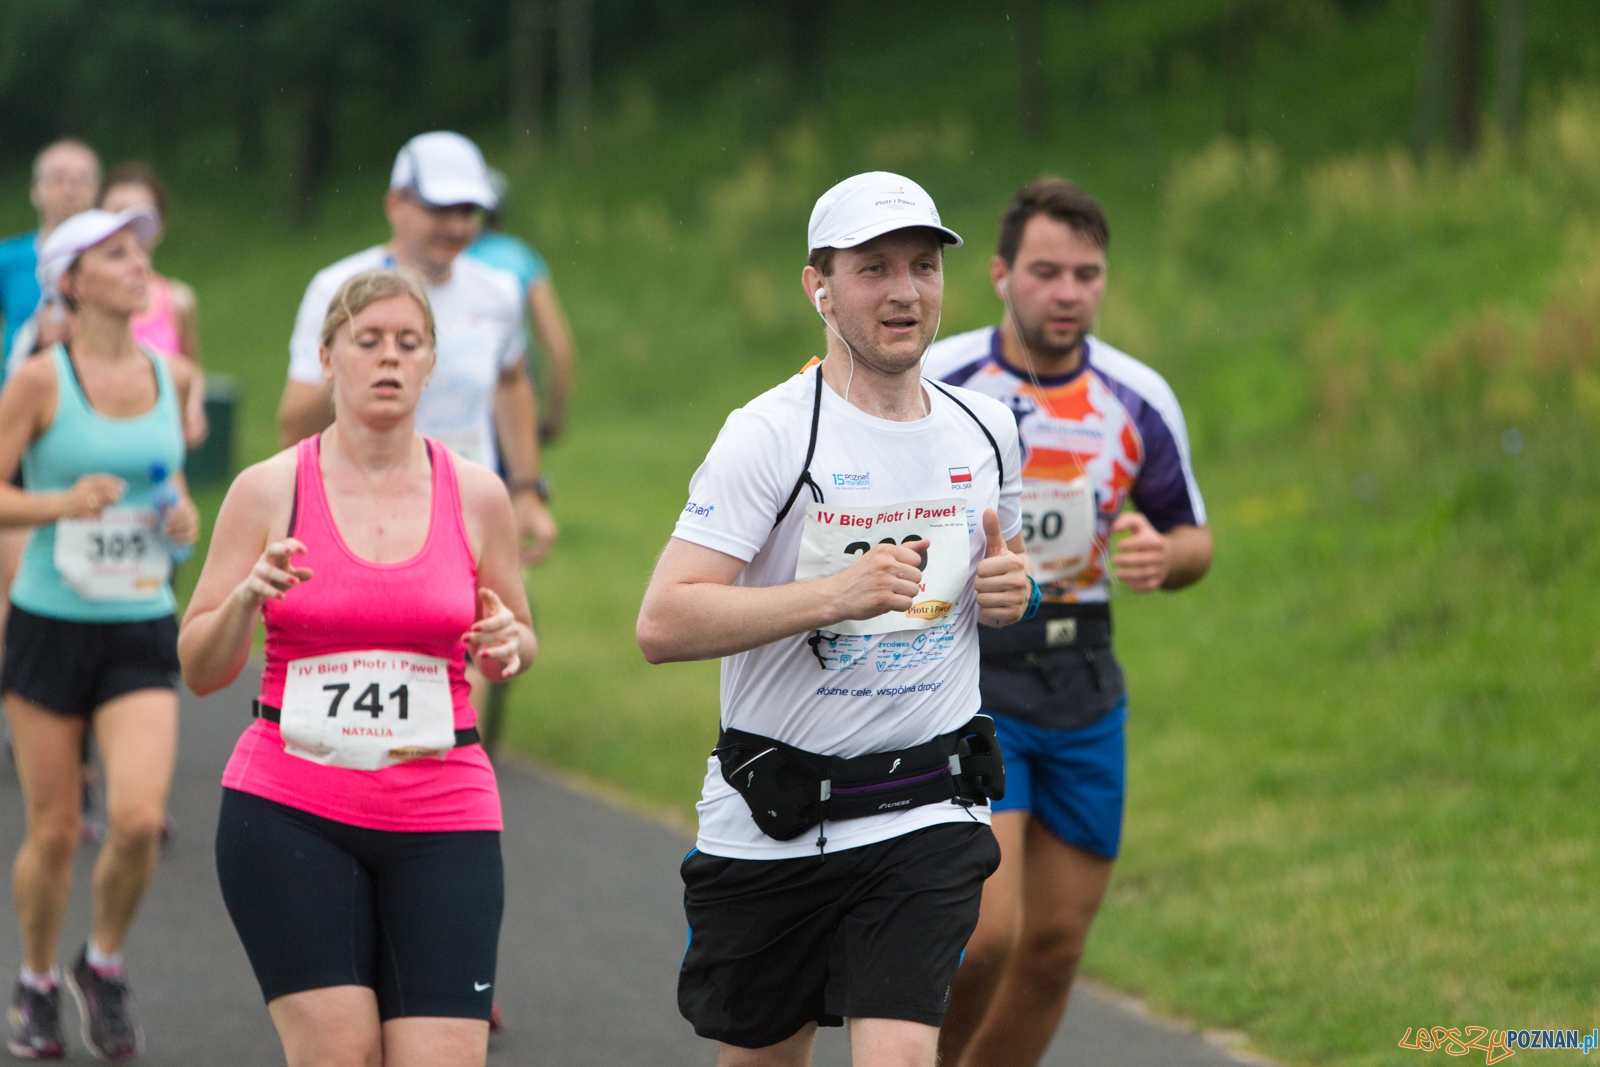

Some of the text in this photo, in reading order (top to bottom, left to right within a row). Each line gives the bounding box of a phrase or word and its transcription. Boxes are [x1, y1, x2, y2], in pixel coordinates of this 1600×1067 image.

[832, 473, 845, 486] 15
[817, 505, 956, 529] IV Bieg Piotr i Paweł
[299, 666, 313, 676] IV
[318, 662, 348, 675] Bieg
[353, 659, 387, 670] Piotr
[392, 659, 397, 670] i
[816, 687, 849, 696] Różne
[850, 687, 873, 697] cele,
[876, 685, 916, 698] wspólna
[322, 682, 409, 719] 741
[341, 727, 394, 738] NATALIA
